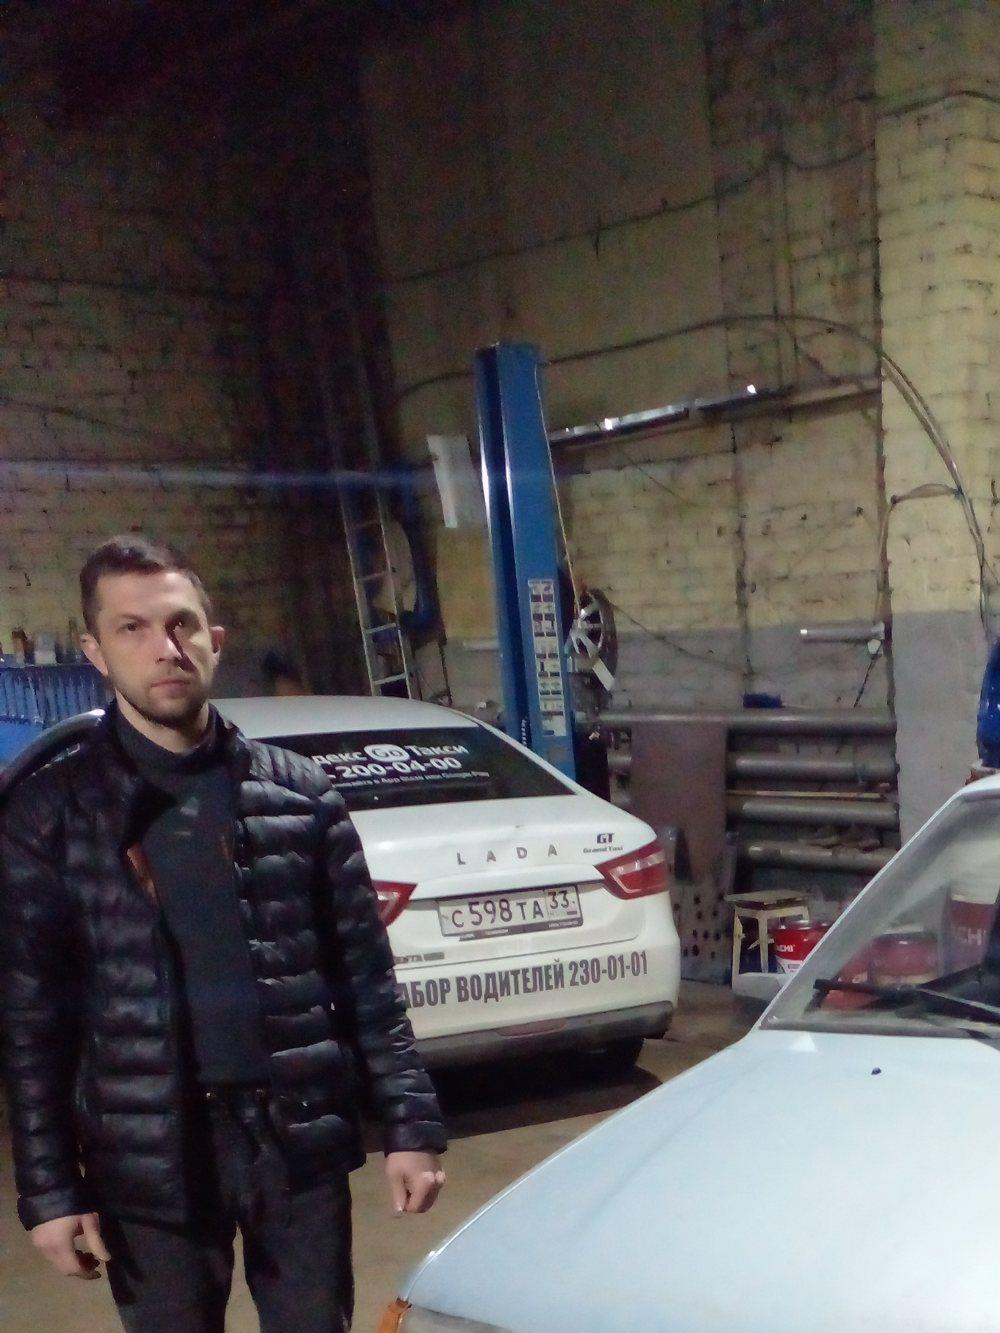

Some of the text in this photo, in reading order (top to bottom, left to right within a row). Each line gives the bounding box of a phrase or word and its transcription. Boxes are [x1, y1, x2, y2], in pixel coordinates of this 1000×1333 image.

[311, 752, 368, 766] декс
[404, 745, 470, 758] Такси
[335, 757, 462, 779] 200-04-00
[597, 833, 614, 844] GT
[456, 844, 558, 865] LADA
[548, 890, 569, 909] 33
[395, 950, 648, 1008] АБОР ВОДИТЕЛЕЙ 230-01-01
